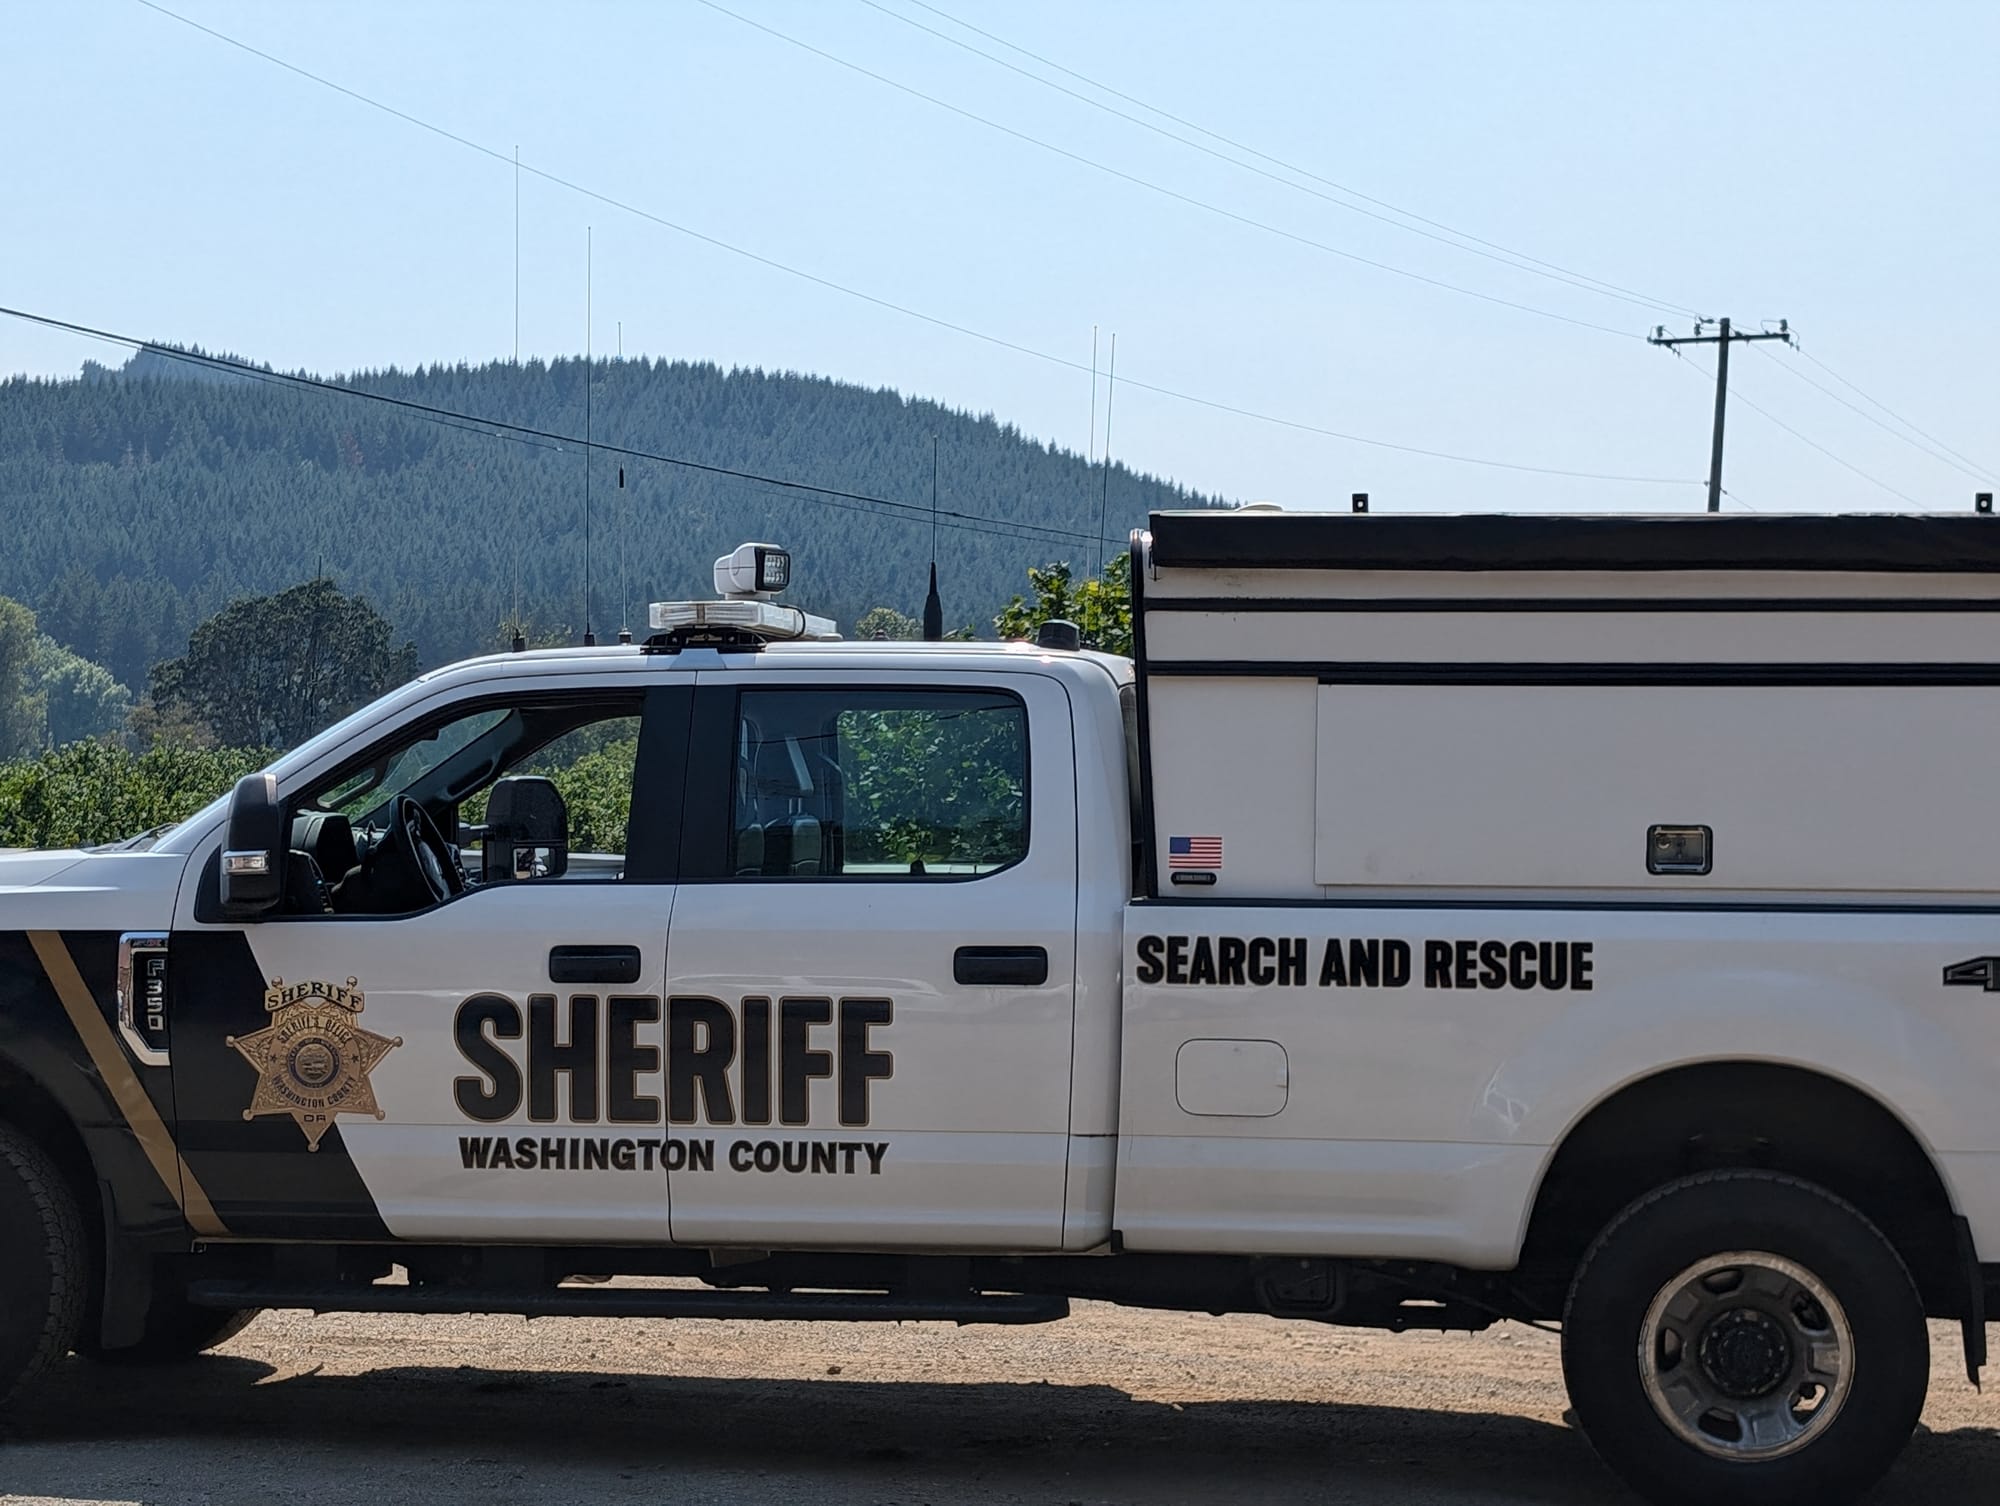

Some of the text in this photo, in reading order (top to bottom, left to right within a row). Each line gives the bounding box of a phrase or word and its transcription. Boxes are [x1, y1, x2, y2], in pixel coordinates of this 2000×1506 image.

[1136, 935, 1594, 990] SEARCH AND RESCUE
[147, 959, 165, 1031] F350
[267, 981, 362, 1009] SHERIFF
[453, 992, 894, 1127] SHERIFF
[458, 1136, 890, 1175] WASHINGTON COUNTY
